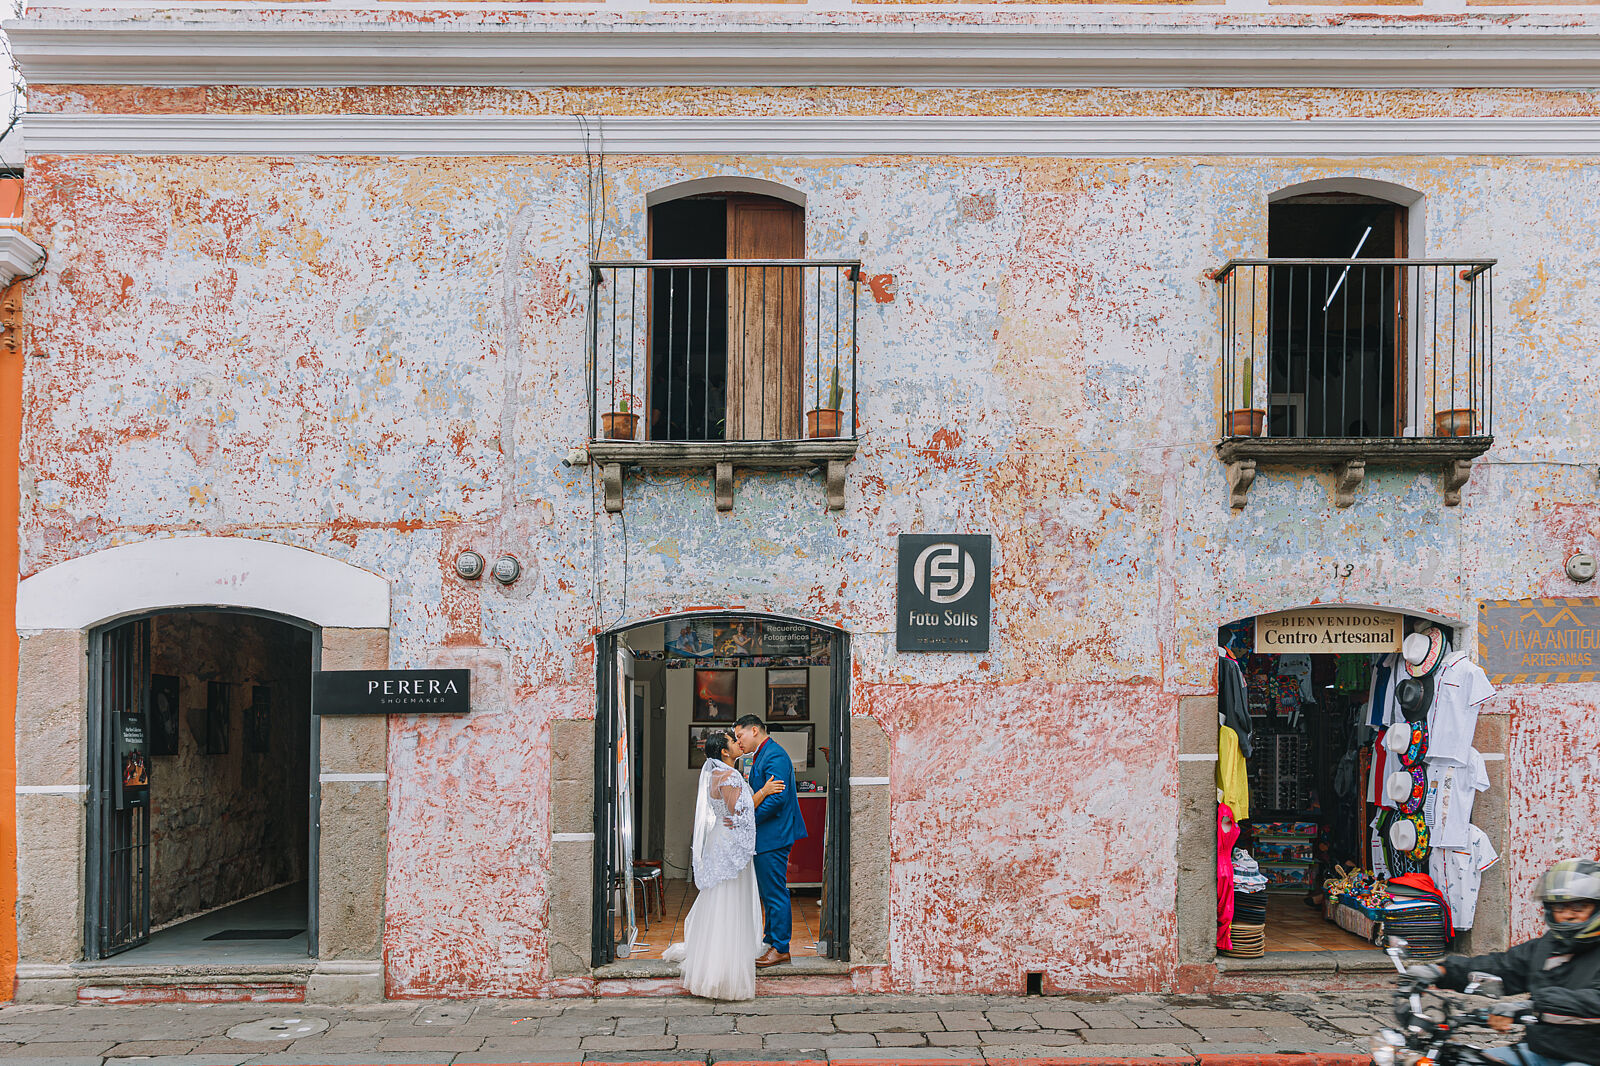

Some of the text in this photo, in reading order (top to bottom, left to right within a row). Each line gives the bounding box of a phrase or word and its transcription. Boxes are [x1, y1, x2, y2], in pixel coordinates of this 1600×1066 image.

[1332, 562, 1355, 580] 13
[909, 609, 978, 627] Foto Solis
[1281, 615, 1381, 627] BIENVENIDOS
[766, 624, 807, 632] Recuerdos
[763, 634, 810, 642] Fotográficos
[1264, 628, 1394, 645] Centro Artesanal
[1520, 652, 1592, 667] ARTESANIAS
[368, 679, 458, 695] PERERA
